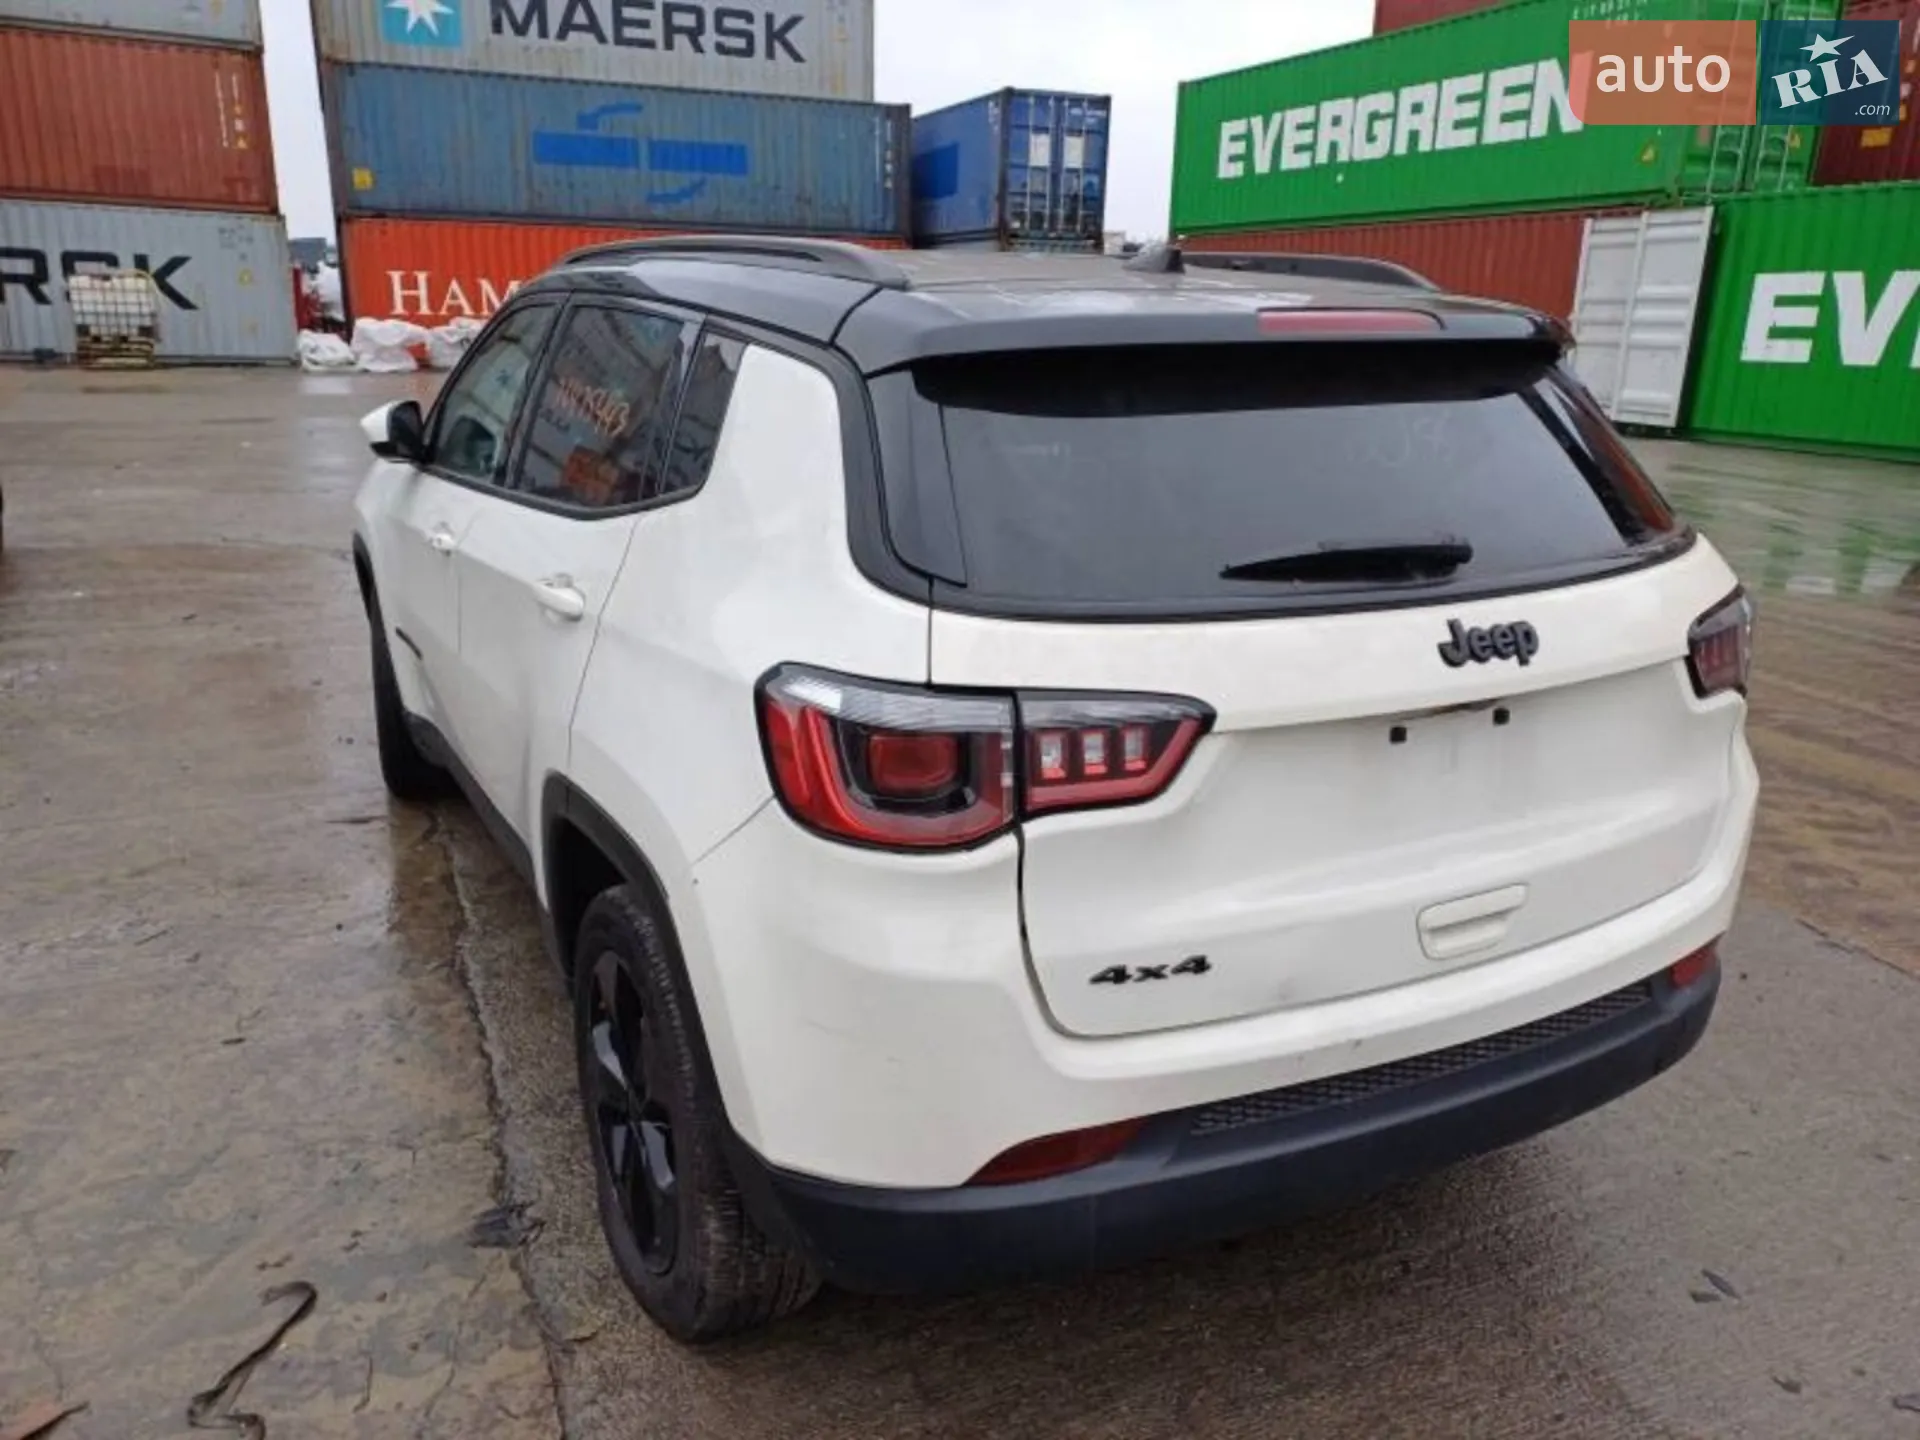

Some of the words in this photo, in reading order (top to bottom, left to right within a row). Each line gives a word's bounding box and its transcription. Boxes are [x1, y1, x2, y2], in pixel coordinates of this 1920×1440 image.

[490, 0, 806, 63] MAERSK
[1216, 50, 1595, 179] EVERGREEN
[1740, 269, 1920, 369] EV
[1437, 618, 1539, 668] Jeep
[1089, 954, 1211, 985] 4x4
